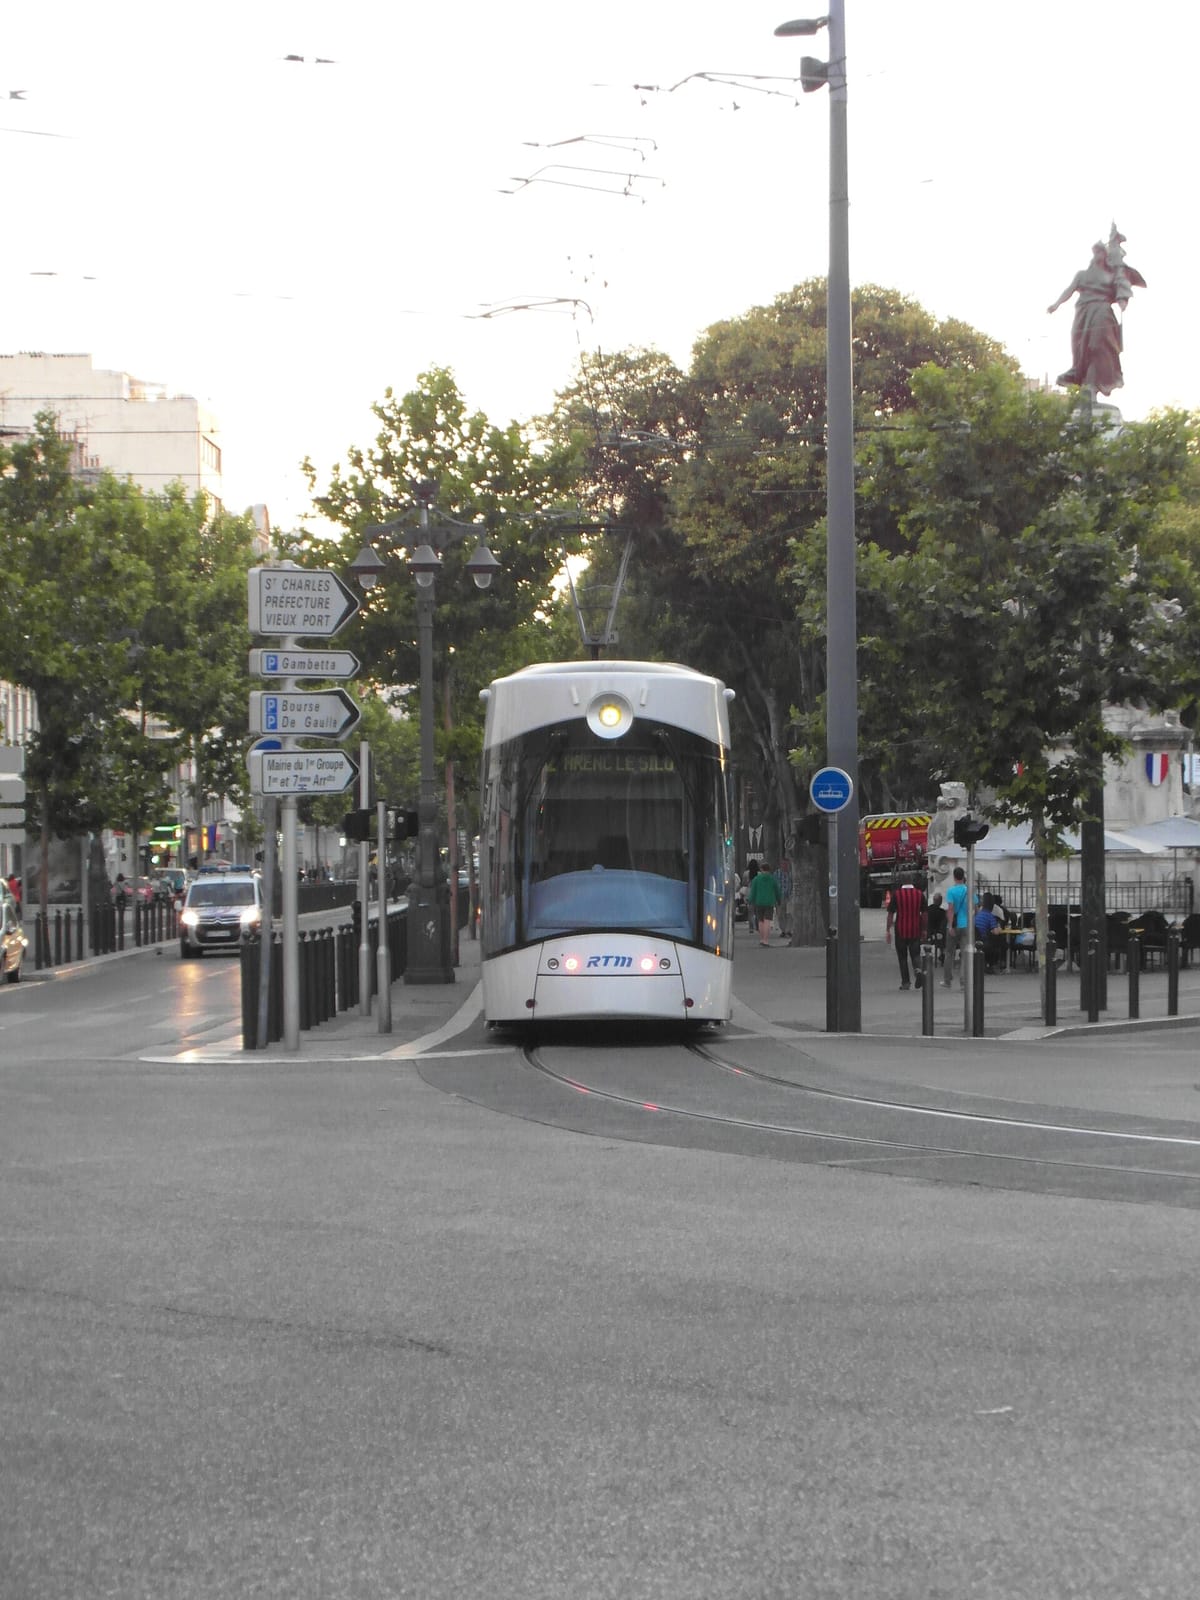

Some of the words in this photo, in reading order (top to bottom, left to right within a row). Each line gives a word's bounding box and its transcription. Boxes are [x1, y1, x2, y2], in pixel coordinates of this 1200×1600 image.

[282, 578, 330, 592] CHARLES
[266, 613, 297, 626] VIEUX
[303, 614, 331, 627] PORT
[267, 656, 276, 669] P
[282, 657, 336, 670] Gambetta
[267, 699, 276, 712] P
[281, 700, 320, 712] Bourse
[267, 715, 276, 728] P
[281, 716, 296, 728] De
[305, 716, 338, 728] Gaulle
[267, 758, 292, 770] Mairie
[294, 758, 303, 770] du
[316, 758, 344, 772] Groupe
[280, 777, 289, 787] et
[586, 955, 633, 968] RTM
